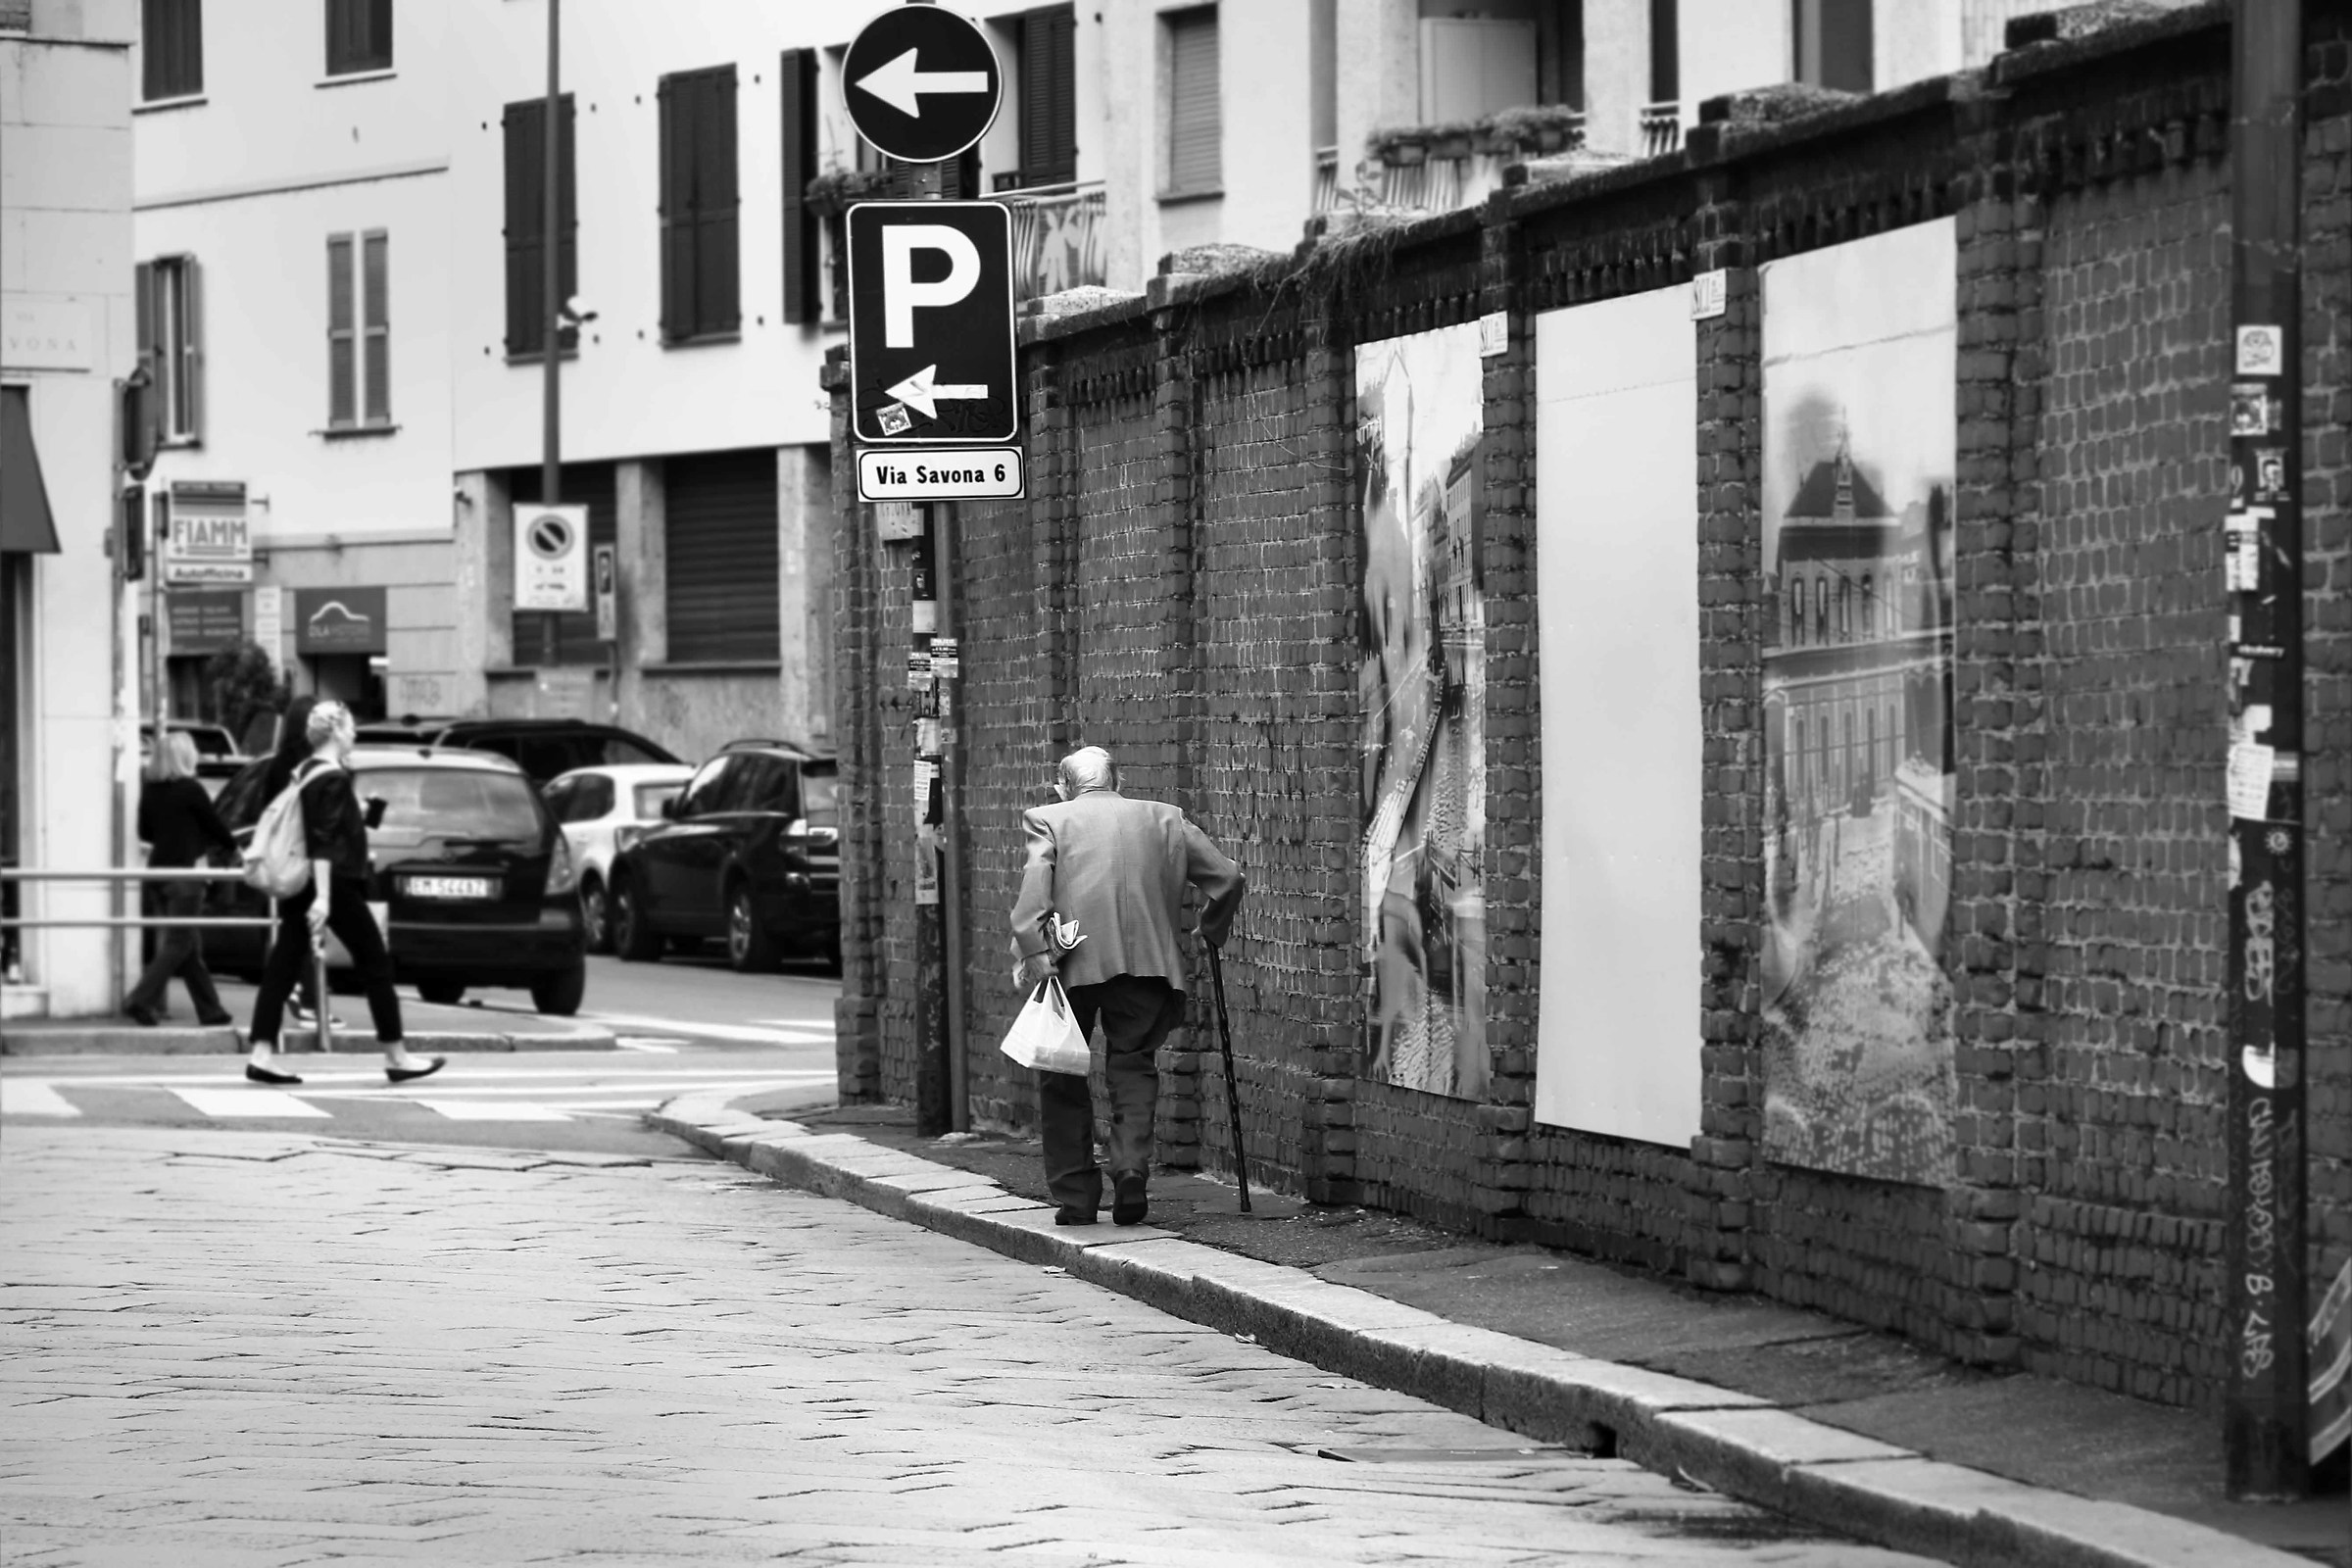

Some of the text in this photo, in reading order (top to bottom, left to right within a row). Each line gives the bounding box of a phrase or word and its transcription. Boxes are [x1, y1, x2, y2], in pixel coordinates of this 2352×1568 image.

[882, 224, 981, 348] P
[876, 464, 1005, 484] Via Savona 6
[173, 519, 247, 544] FIAMM
